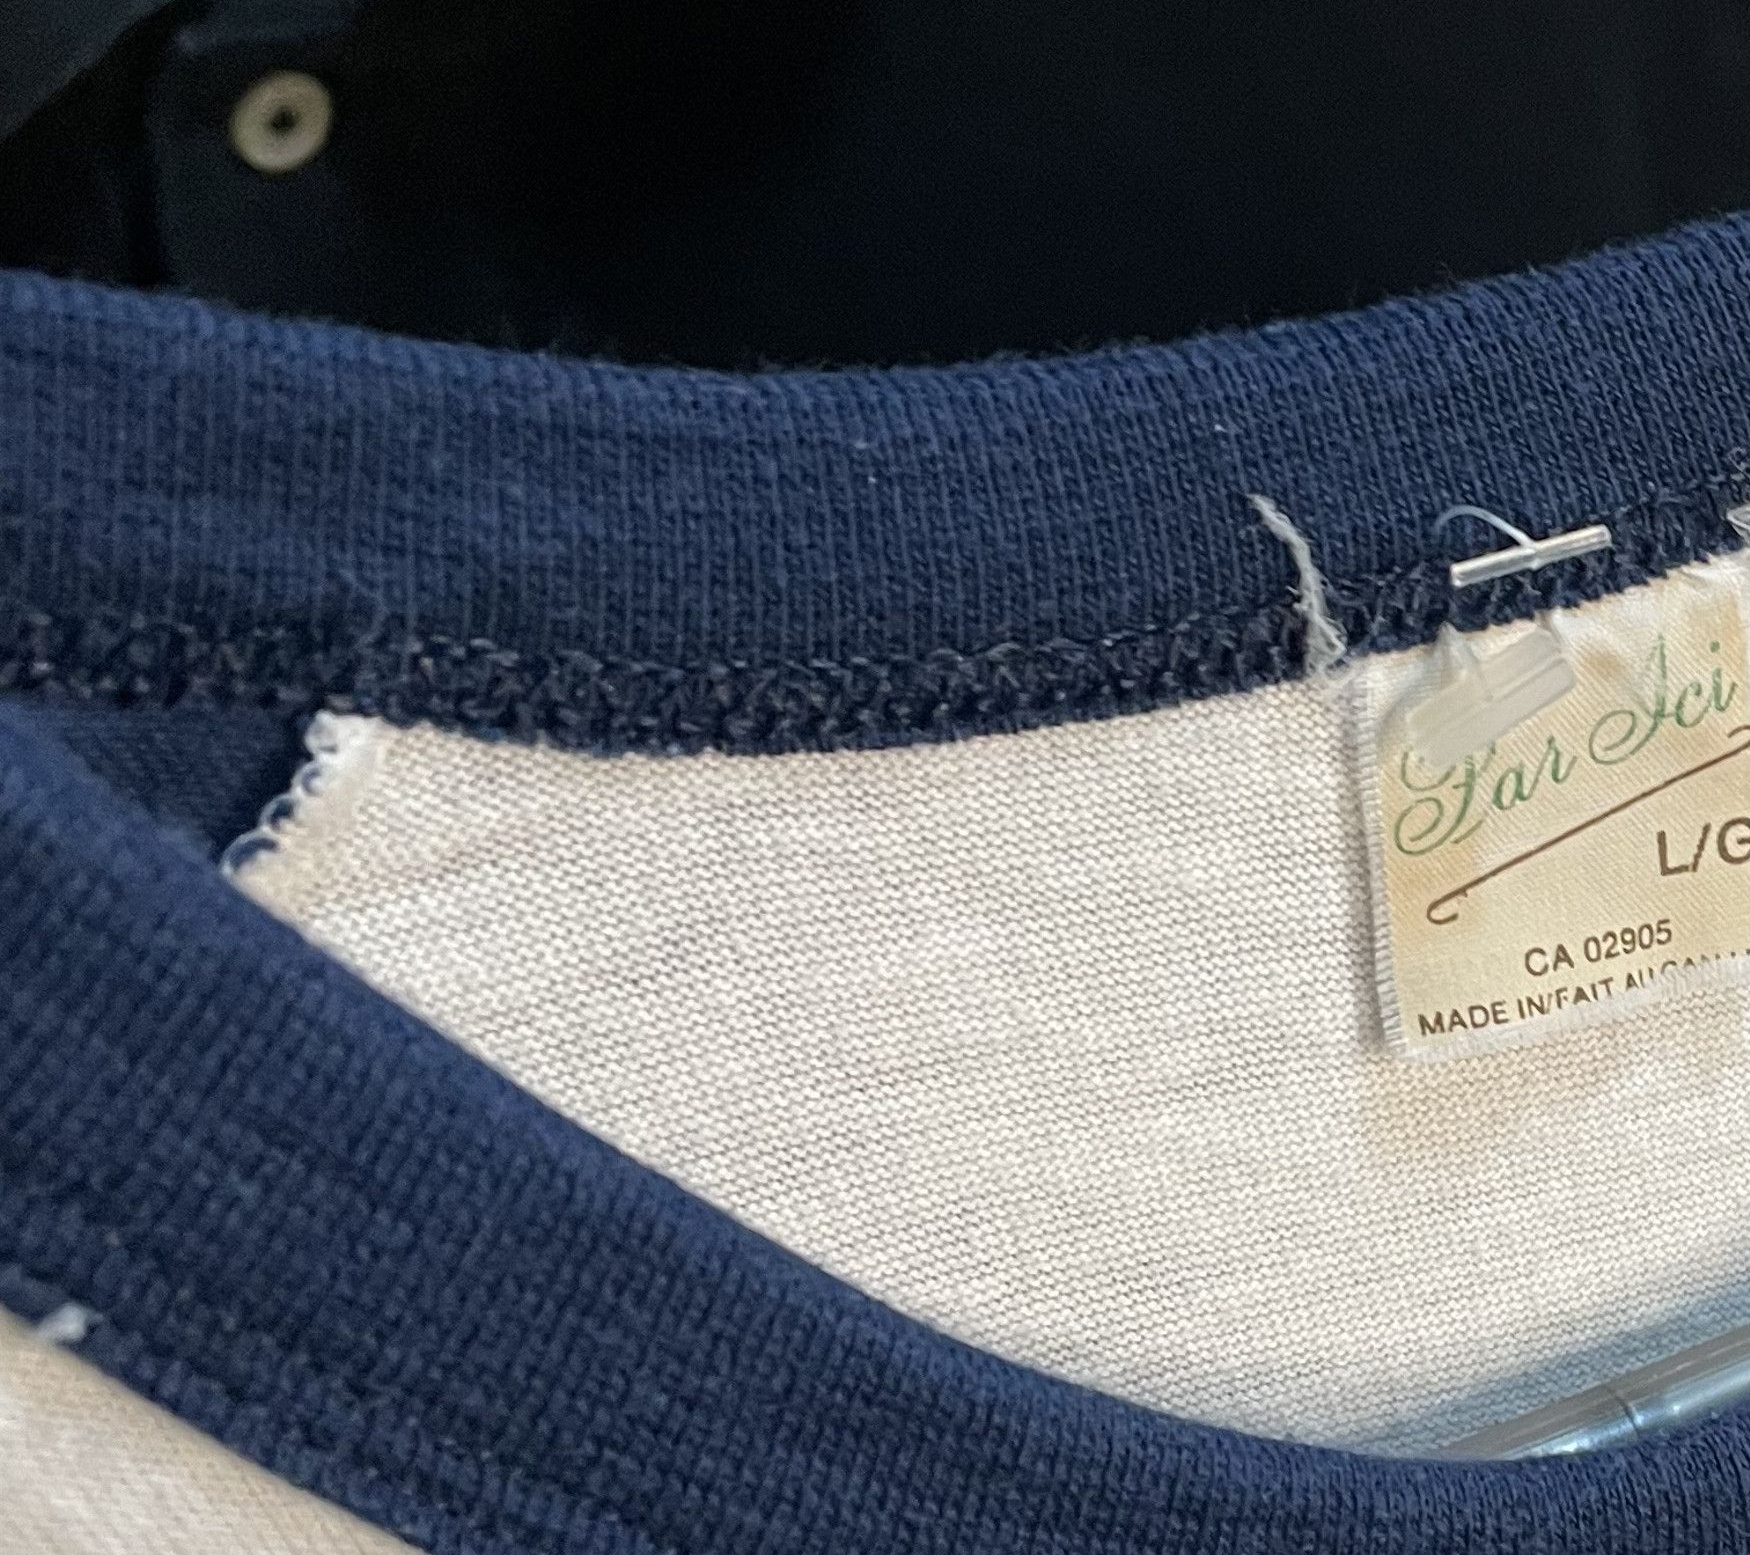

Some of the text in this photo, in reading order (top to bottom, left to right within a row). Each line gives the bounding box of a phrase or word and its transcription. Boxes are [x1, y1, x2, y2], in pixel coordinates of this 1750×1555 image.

[1524, 943, 1575, 977] CA
[1583, 918, 1673, 963] 02905
[1417, 999, 1510, 1037] MADE
